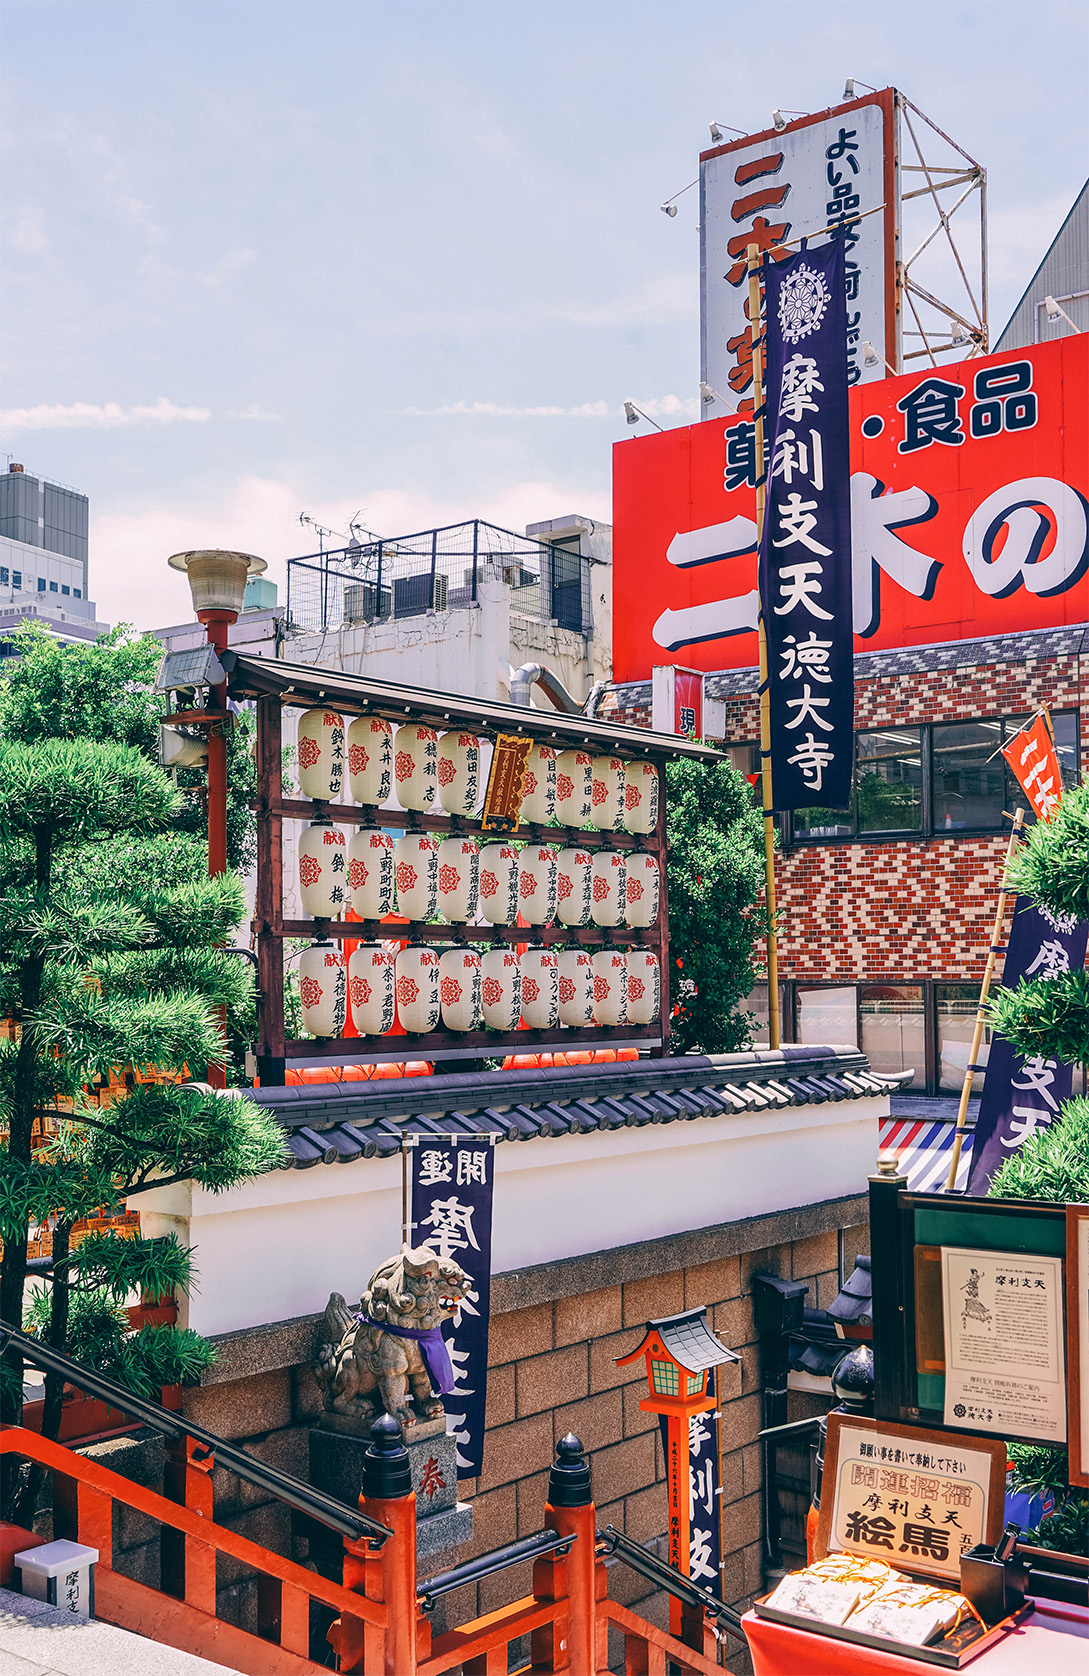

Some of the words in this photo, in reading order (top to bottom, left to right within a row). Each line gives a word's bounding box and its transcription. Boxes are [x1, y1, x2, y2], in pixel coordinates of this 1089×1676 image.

[772, 353, 835, 791] 摩利支天徳大寺
[329, 728, 345, 793] 鈴木勝也
[376, 734, 393, 799] 永井良樹
[462, 748, 478, 811] 細田友紀子
[1000, 938, 1070, 1148] 摩支天
[995, 1275, 1046, 1289] 摩利支天
[419, 1457, 446, 1499] 奉
[859, 1442, 967, 1474] 御願い事を書いて奉納して下さい
[850, 1463, 973, 1507] 開運招福
[862, 1493, 963, 1529] 摩利支天
[845, 1510, 951, 1561] 絵馬
[959, 1533, 973, 1564] 五百
